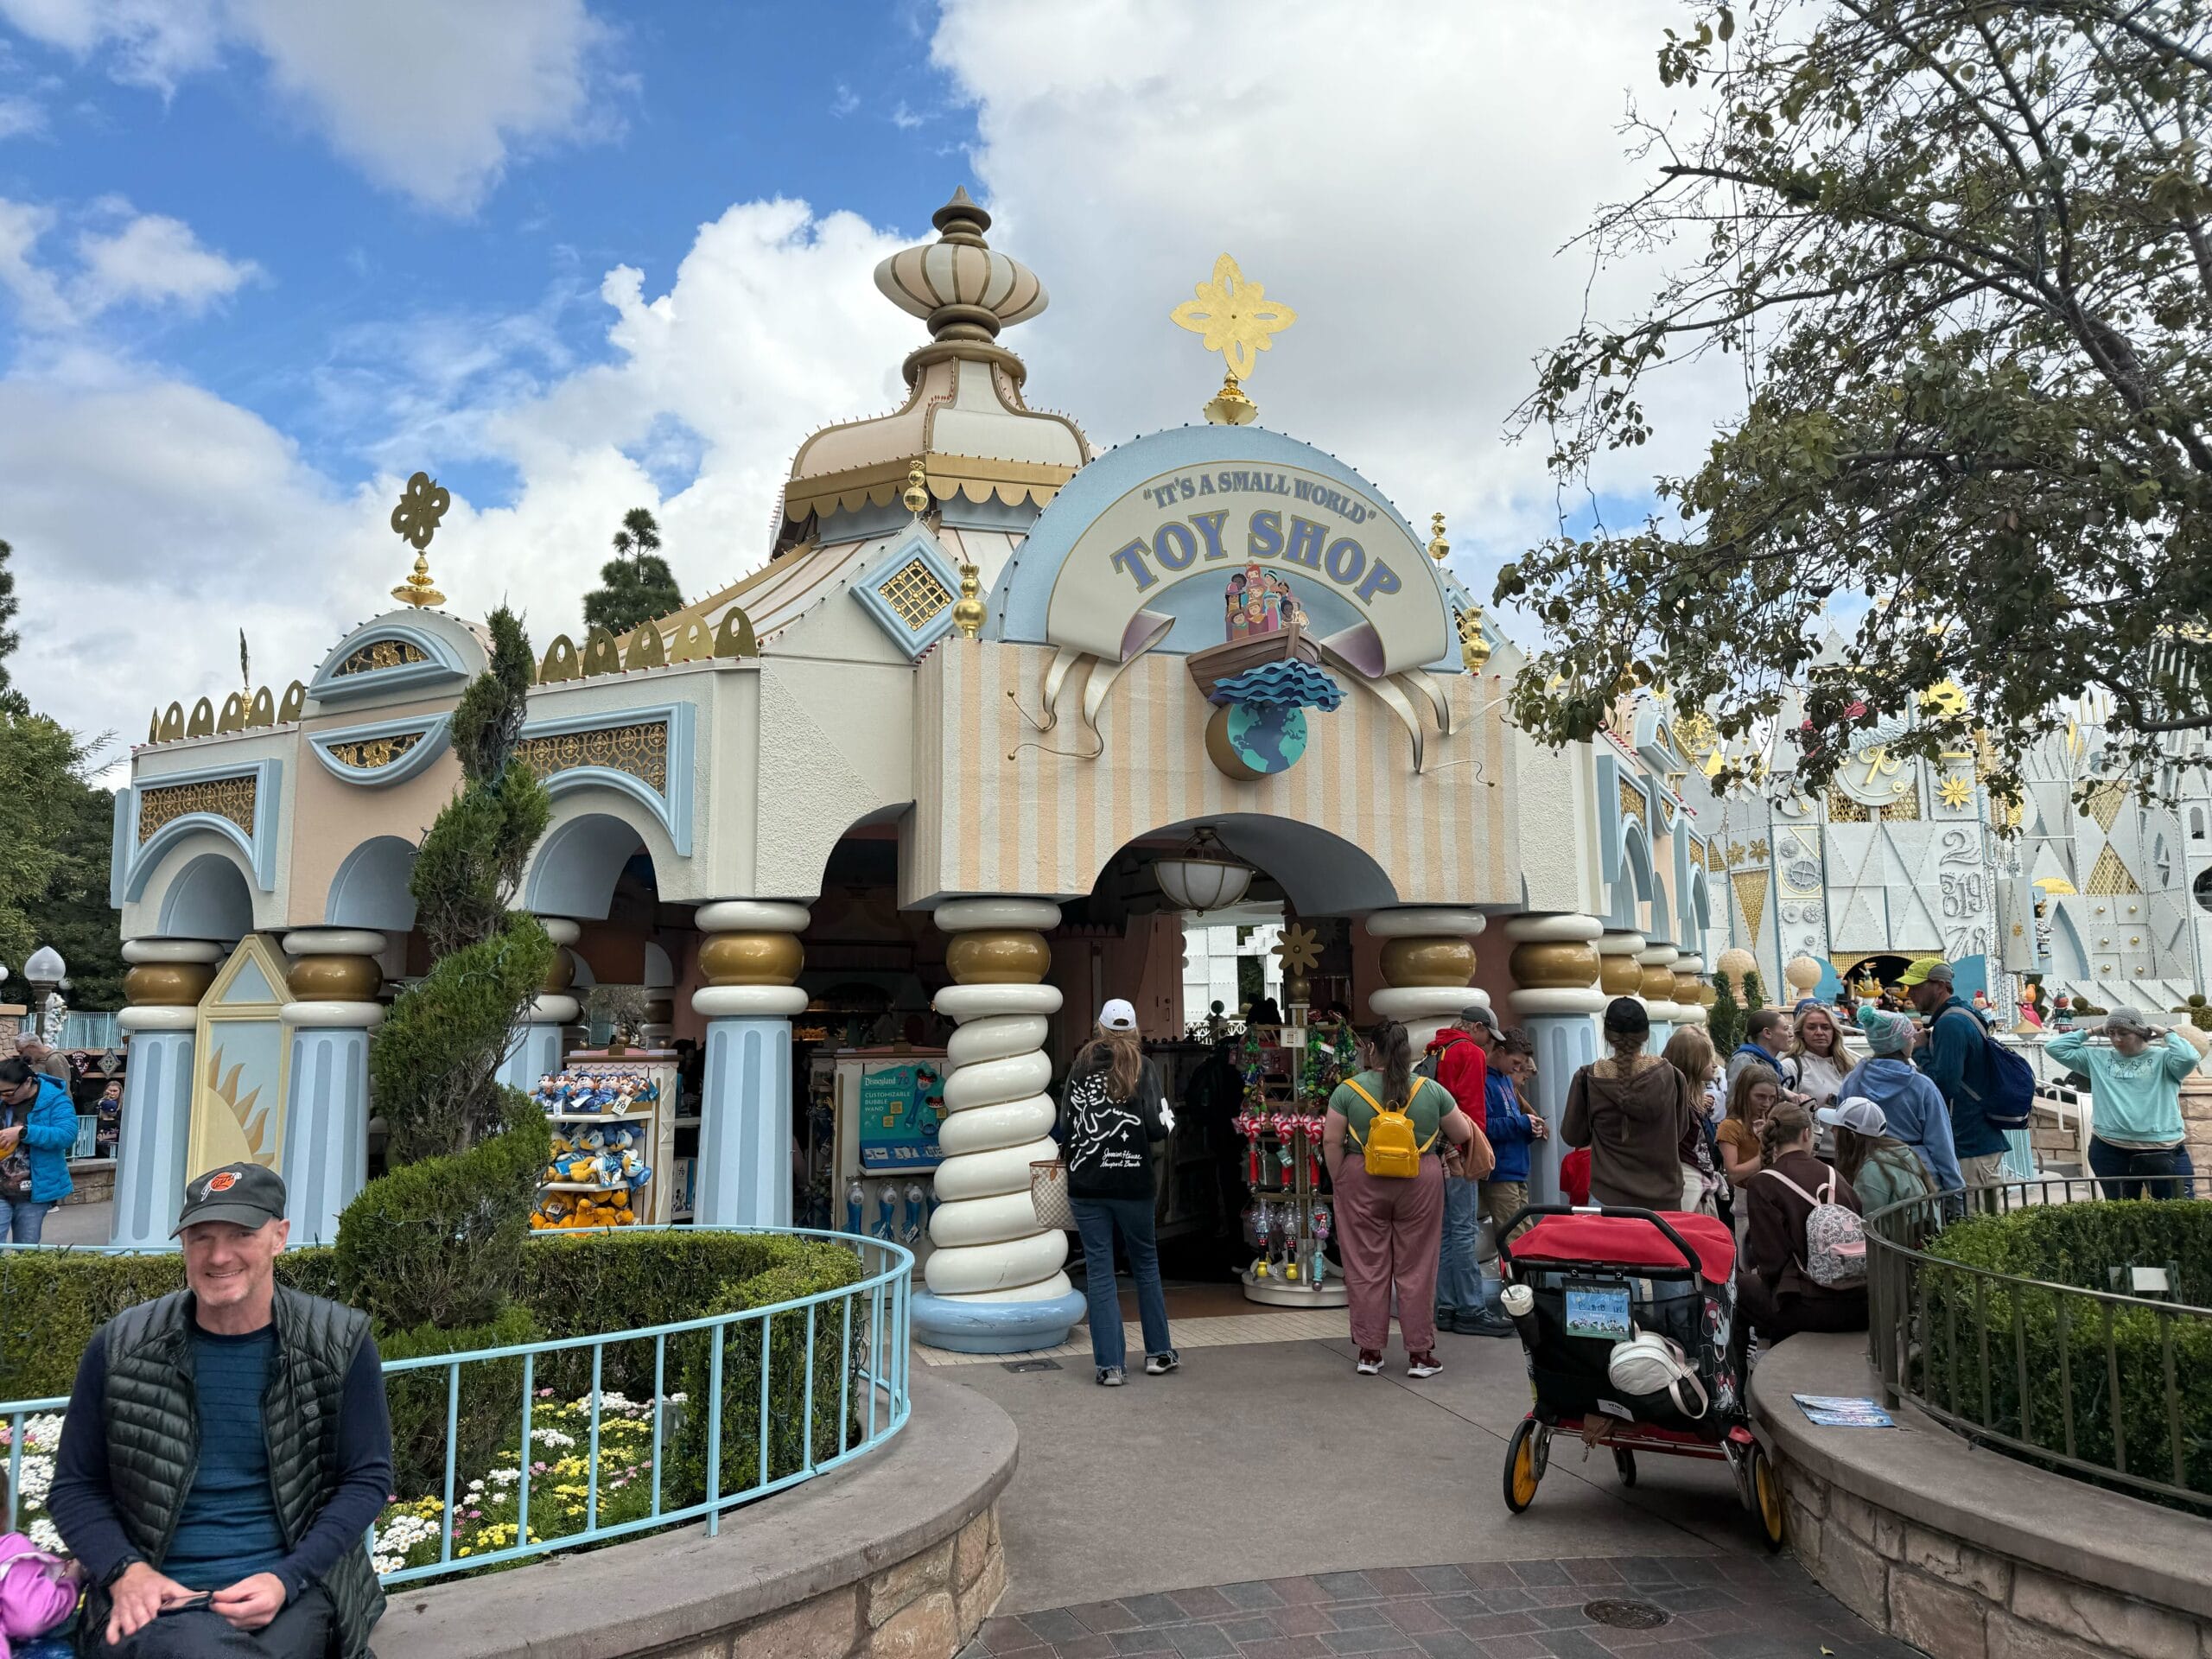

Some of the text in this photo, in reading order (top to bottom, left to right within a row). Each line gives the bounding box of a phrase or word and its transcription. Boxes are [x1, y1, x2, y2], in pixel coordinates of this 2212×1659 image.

[1198, 474, 1217, 497] A
[1217, 470, 1292, 497] SMALL
[1293, 477, 1377, 525] WORLD"
[1109, 508, 1403, 607] TOY SHOP
[865, 1077, 896, 1086] Disneyland
